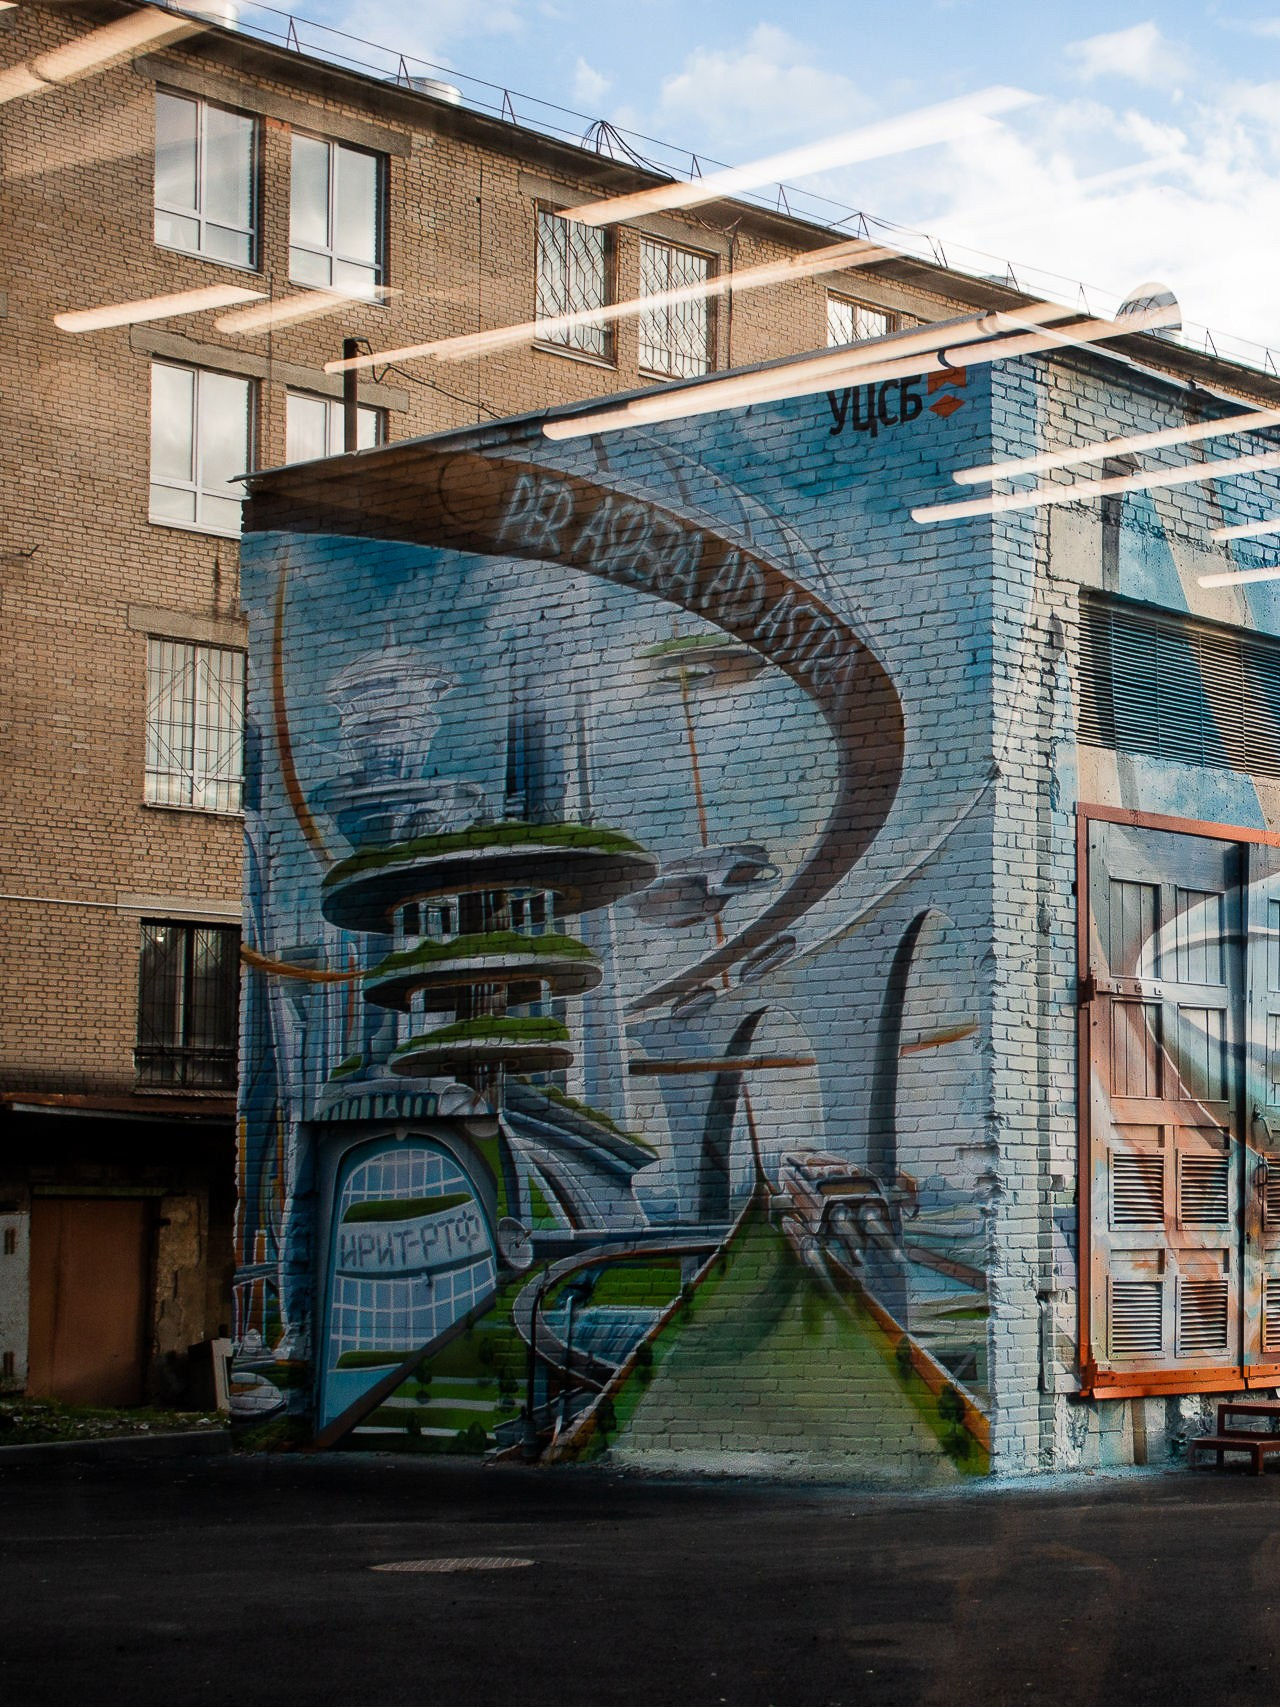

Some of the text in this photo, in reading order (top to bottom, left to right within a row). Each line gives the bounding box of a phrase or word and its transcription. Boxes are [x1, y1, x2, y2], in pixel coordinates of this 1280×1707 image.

[826, 375, 923, 438] УЦСБ
[496, 472, 576, 556] PER
[701, 547, 767, 623] AD
[340, 1210, 480, 1268] ИРИТ-РТФ
